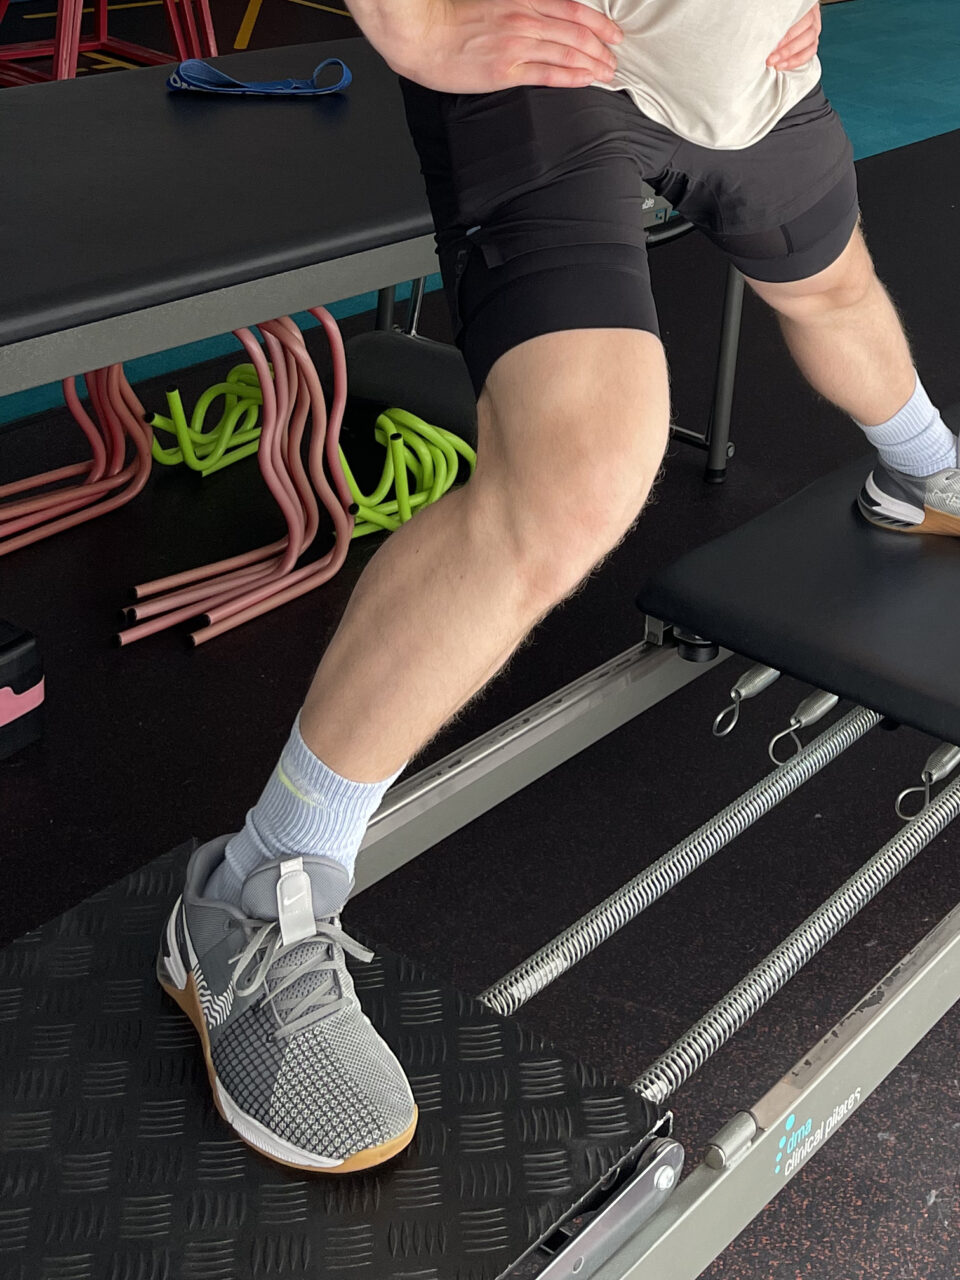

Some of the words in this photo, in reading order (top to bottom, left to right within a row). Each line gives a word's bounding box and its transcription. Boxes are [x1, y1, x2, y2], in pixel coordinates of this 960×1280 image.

[784, 1120, 825, 1176] clinical
[824, 1087, 861, 1139] pilates
[786, 1118, 812, 1154] dma
